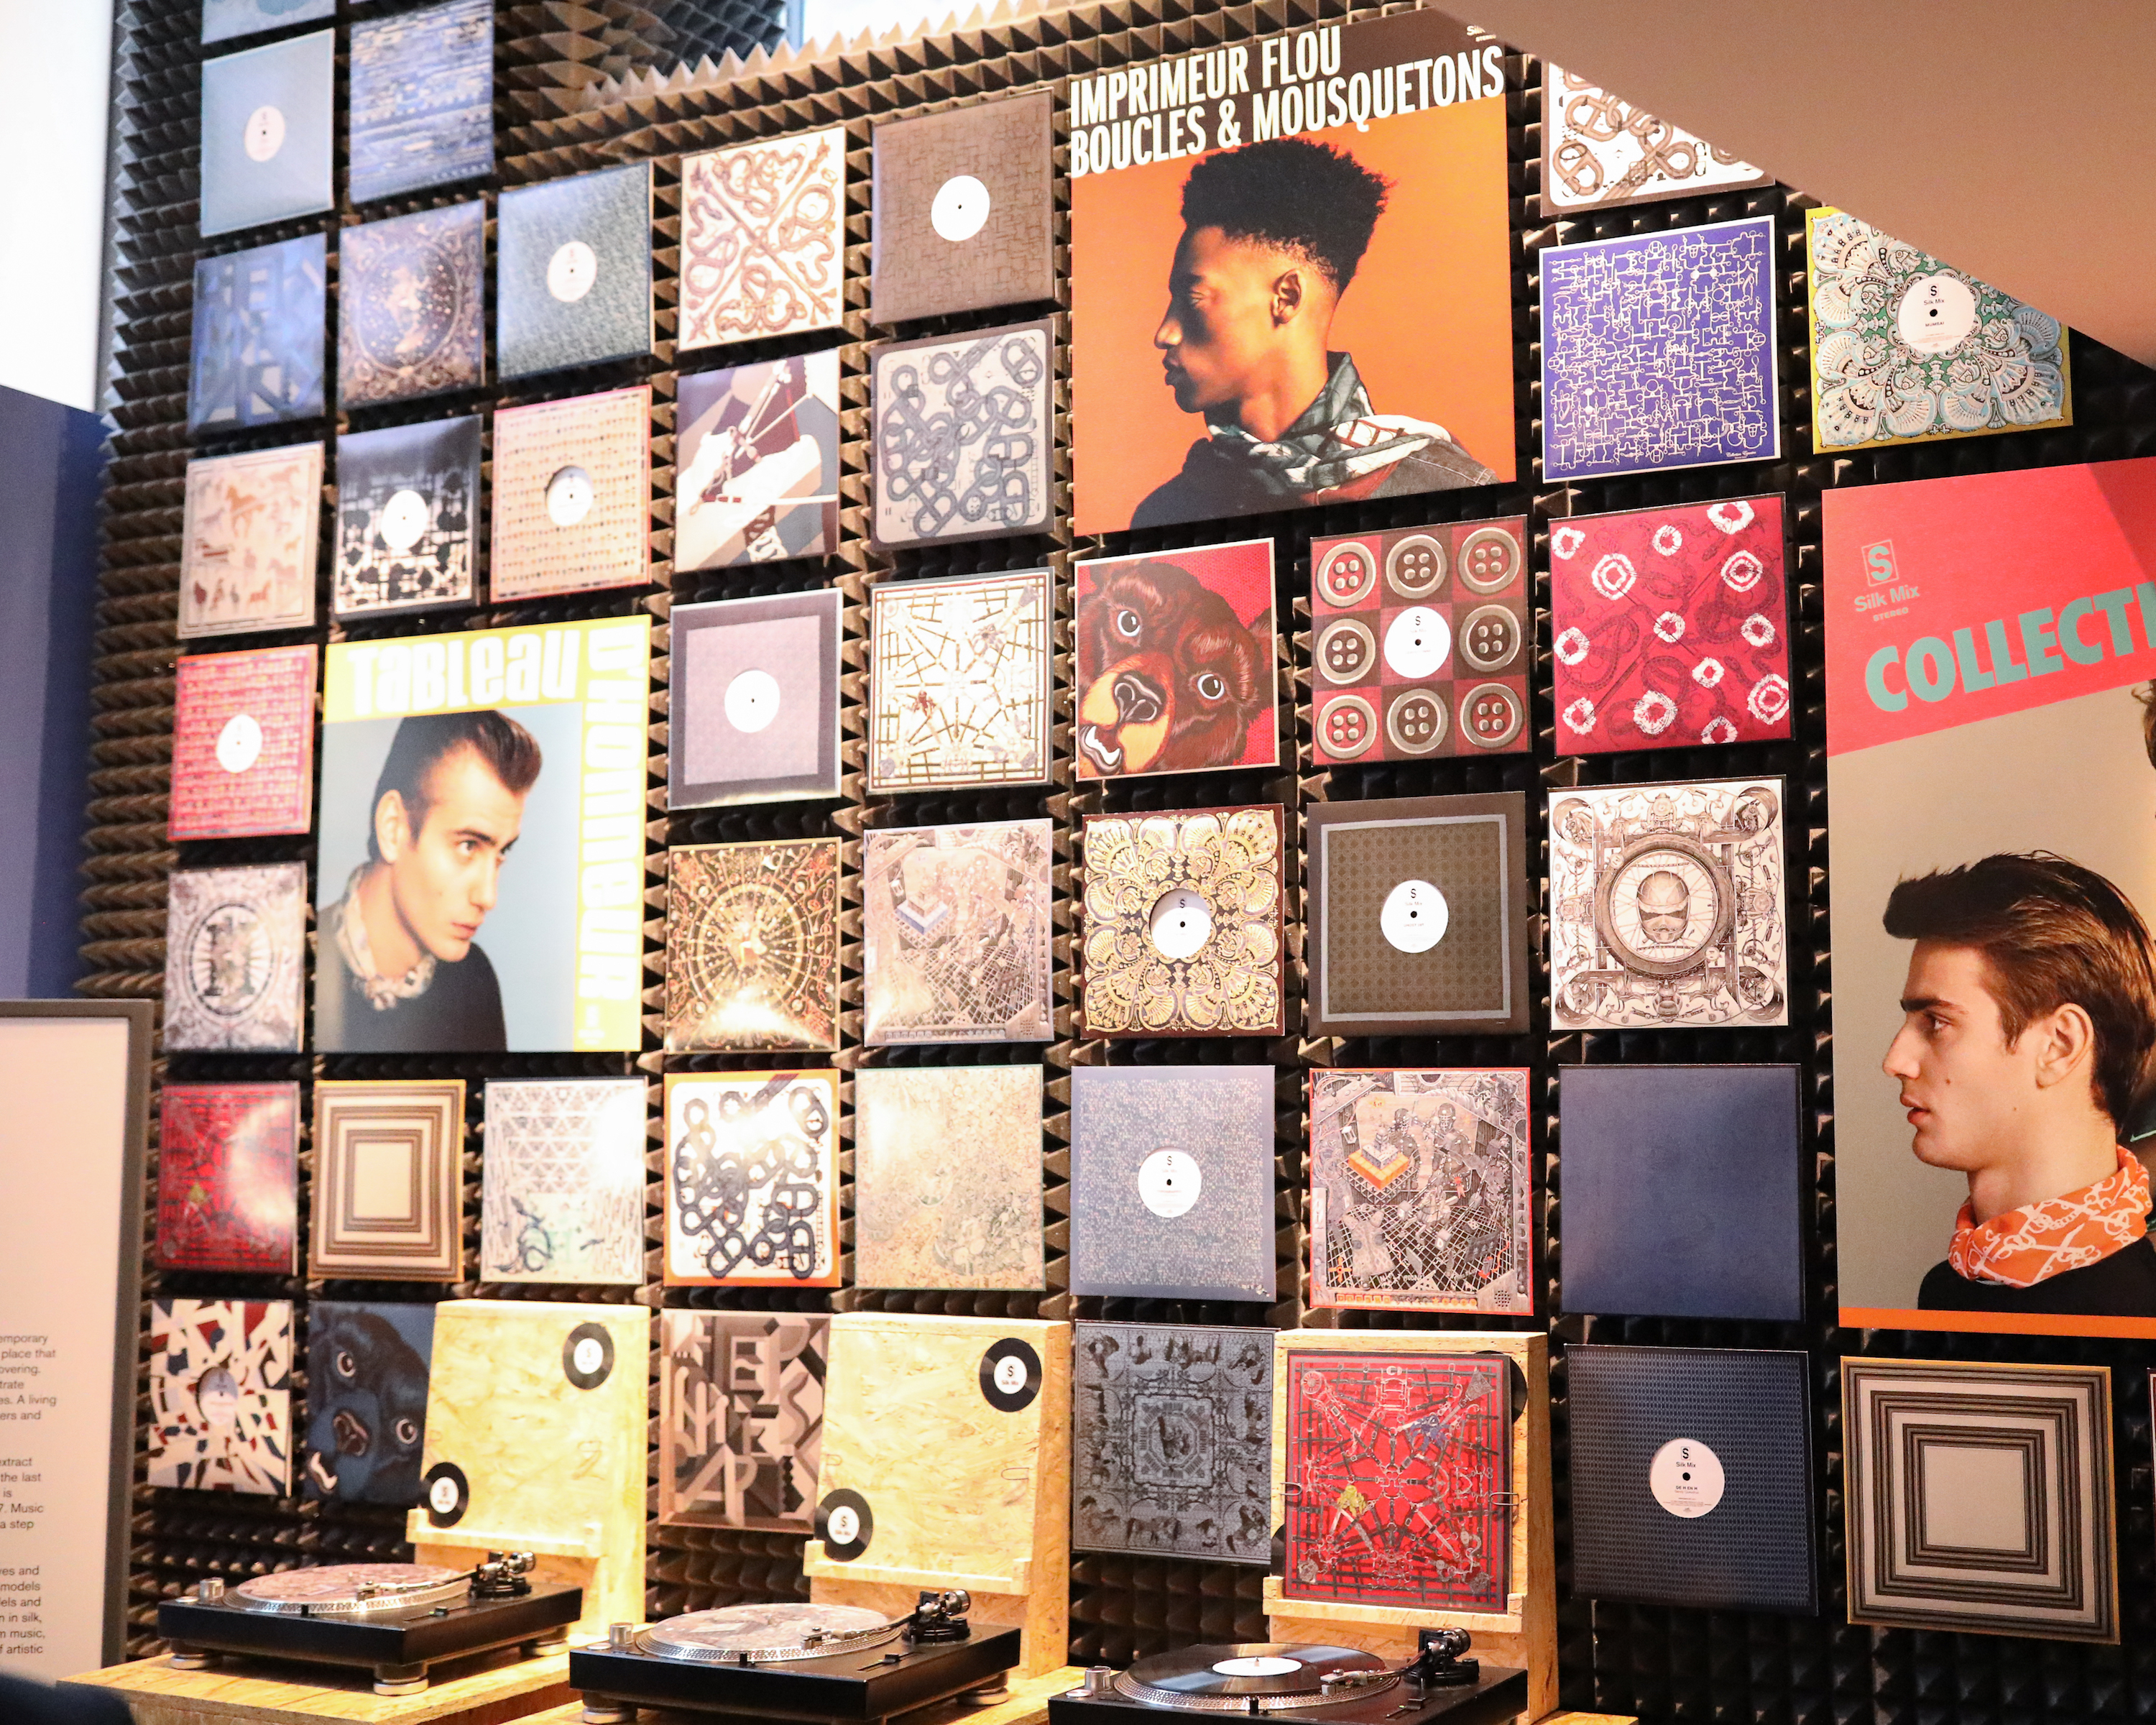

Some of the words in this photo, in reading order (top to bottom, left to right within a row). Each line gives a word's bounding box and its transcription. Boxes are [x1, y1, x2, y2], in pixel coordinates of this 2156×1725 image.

[1070, 45, 1250, 127] IMPRIMEUR
[1261, 25, 1342, 89] FLOU
[1070, 106, 1207, 179] BOUCLES
[1217, 98, 1242, 149] &
[1252, 45, 1505, 142] MOUSQUETONS
[1930, 285, 1938, 296] S
[1868, 545, 1893, 581] S
[1854, 592, 1888, 612] Silk
[1889, 584, 1920, 603] Mix
[1873, 607, 1909, 622] STEREO
[1415, 615, 1421, 625] S
[1411, 888, 1416, 898] S
[1180, 898, 1186, 908] S
[1167, 1156, 1172, 1165] S
[1, 1350, 32, 1360] place
[1008, 1366, 1014, 1376] S
[17, 1395, 25, 1404] A
[29, 1394, 57, 1407] living
[20, 1411, 41, 1420] and
[1682, 1448, 1690, 1459] S
[1, 1473, 17, 1482] the
[22, 1472, 41, 1481] last
[3, 1488, 12, 1497] is
[11, 1503, 44, 1513] Music
[9, 1520, 34, 1530] step
[19, 1565, 40, 1576] and
[0, 1581, 40, 1591] models
[20, 1596, 41, 1606] and
[9, 1612, 17, 1622] in
[22, 1612, 42, 1624] silk,
[10, 1627, 45, 1639] music,
[6, 1643, 43, 1654] artistic
